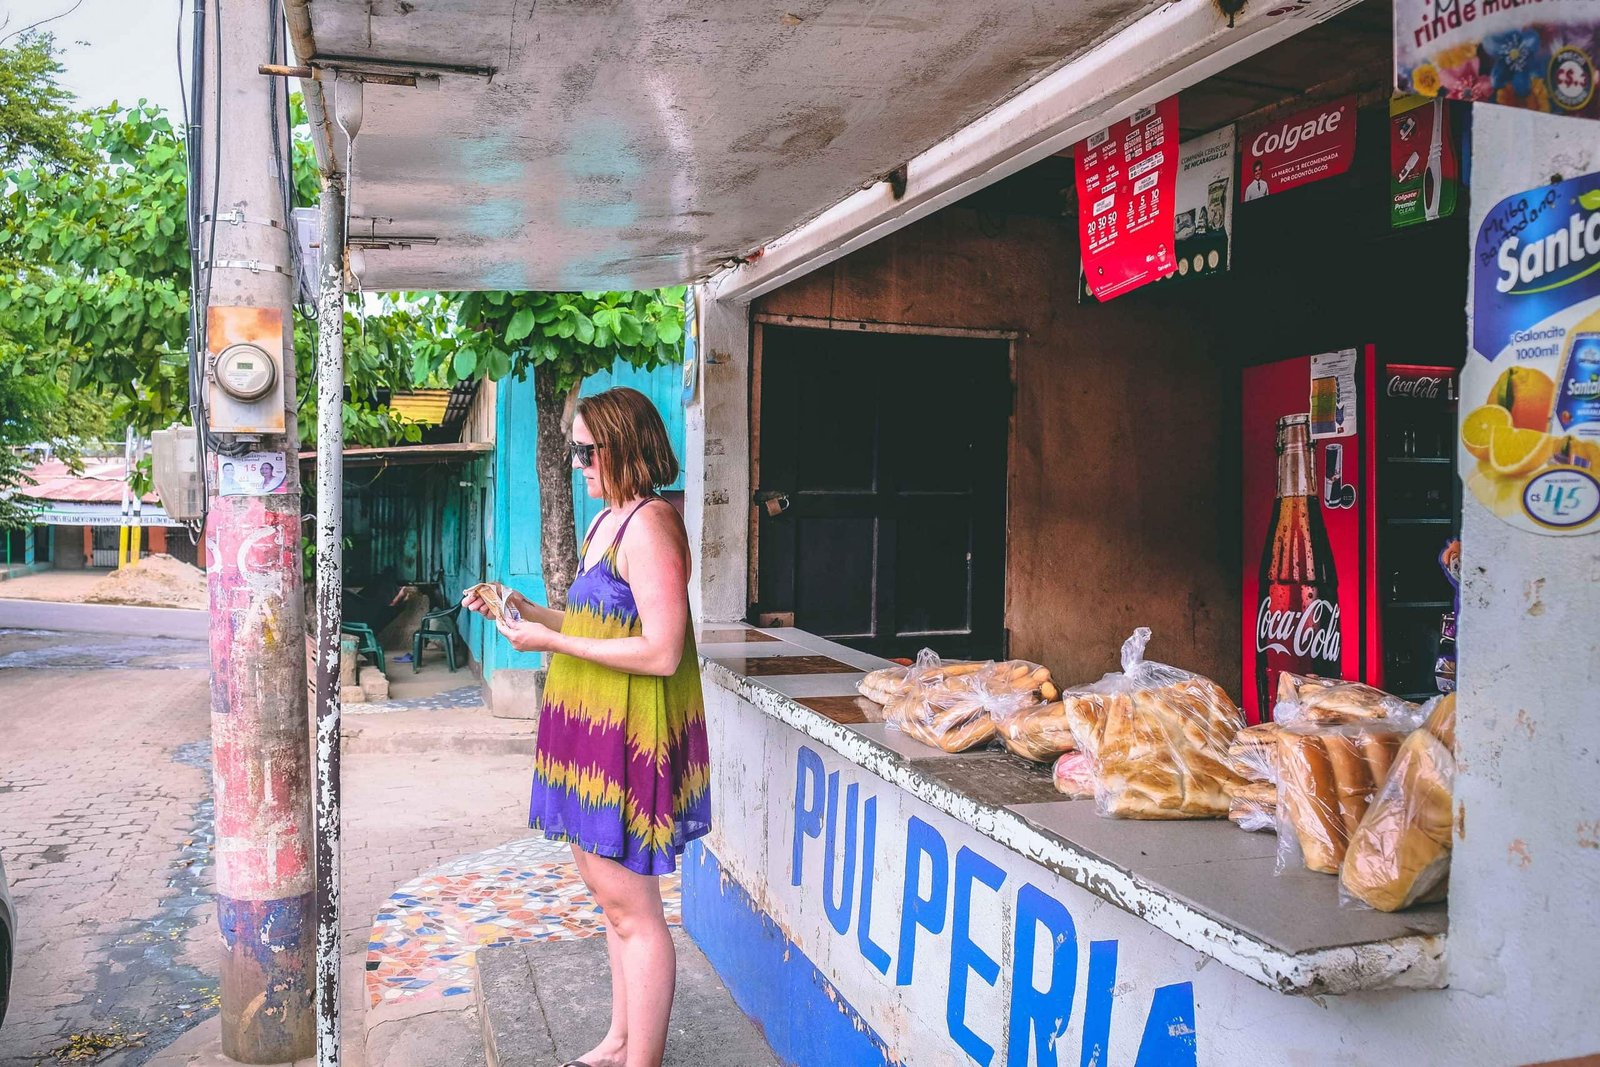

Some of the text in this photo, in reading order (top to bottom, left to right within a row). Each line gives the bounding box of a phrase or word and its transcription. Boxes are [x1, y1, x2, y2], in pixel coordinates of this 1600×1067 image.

[1414, 1, 1476, 48] rinde
[1483, 0, 1543, 16] muc
[1251, 110, 1341, 157] Colgate
[1191, 154, 1218, 168] NICARAGUA
[1278, 166, 1294, 176] MARCA
[1301, 153, 1339, 168] RECOMENDADA
[1280, 175, 1290, 183] POR
[1151, 188, 1159, 200] 10
[1394, 191, 1418, 202] Colgate
[1394, 200, 1417, 210] Premier
[1088, 211, 1117, 234] 20 30 50
[1387, 375, 1441, 398] Coca-Cola
[1257, 596, 1340, 662] Coca-Cola
